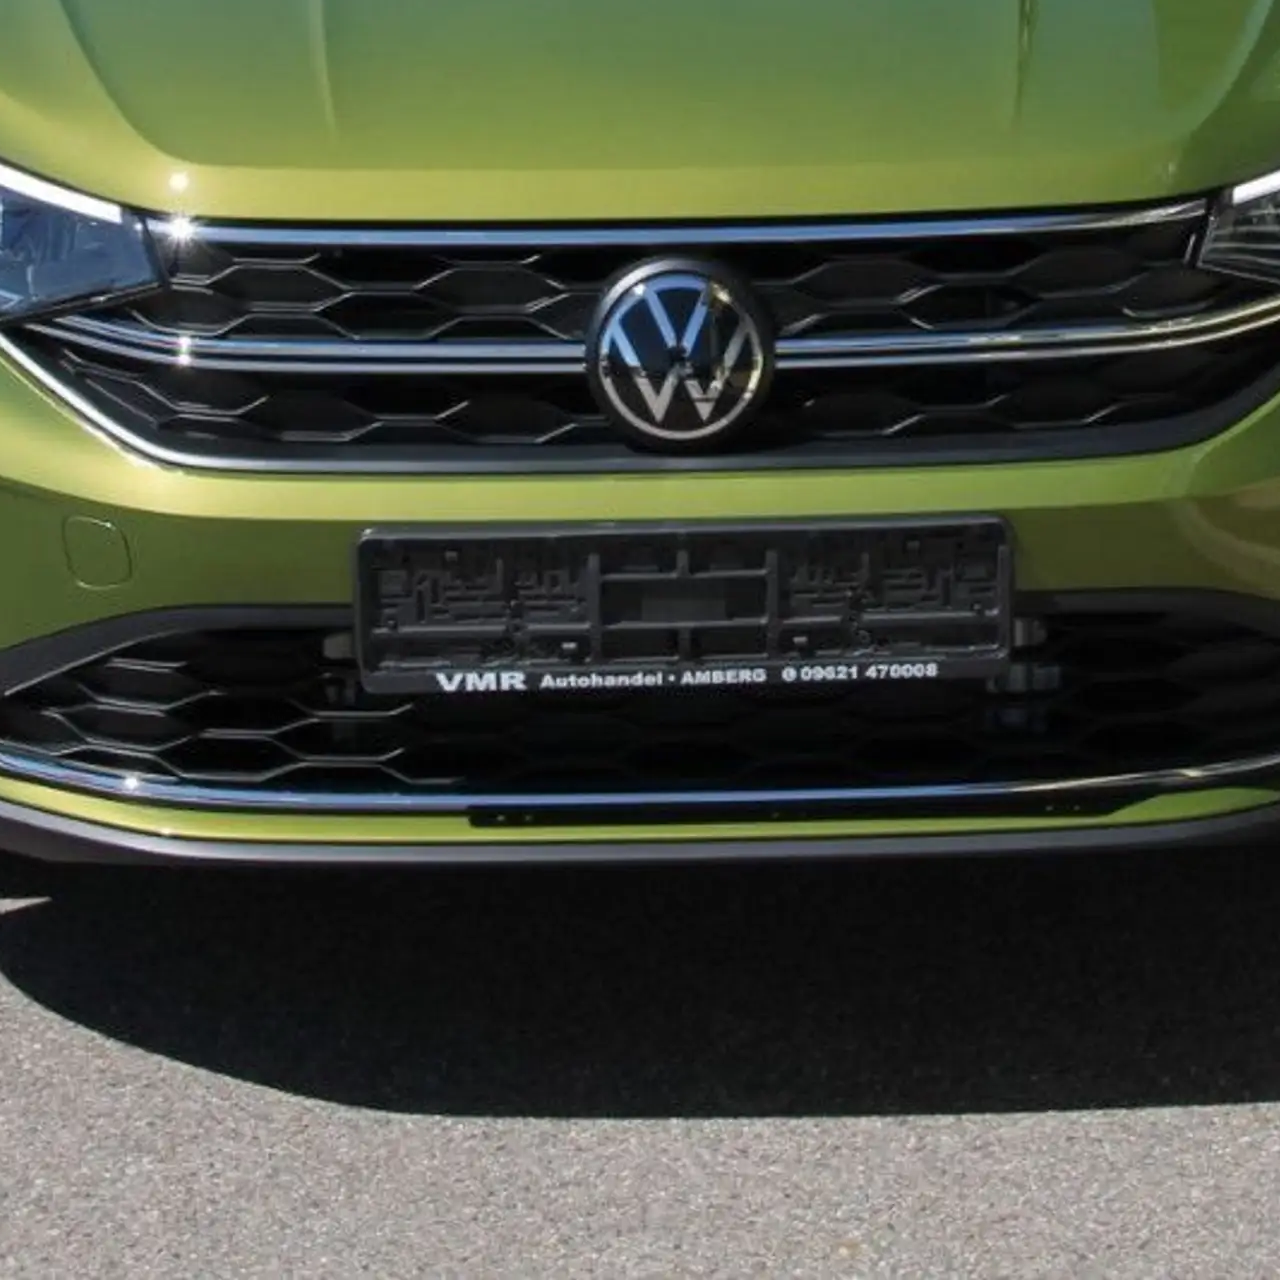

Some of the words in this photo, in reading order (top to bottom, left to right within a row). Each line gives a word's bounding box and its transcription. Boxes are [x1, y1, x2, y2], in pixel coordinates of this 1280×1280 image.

[436, 671, 527, 692] VMR
[540, 671, 663, 689] Autohandel
[680, 669, 767, 685] AMBERG
